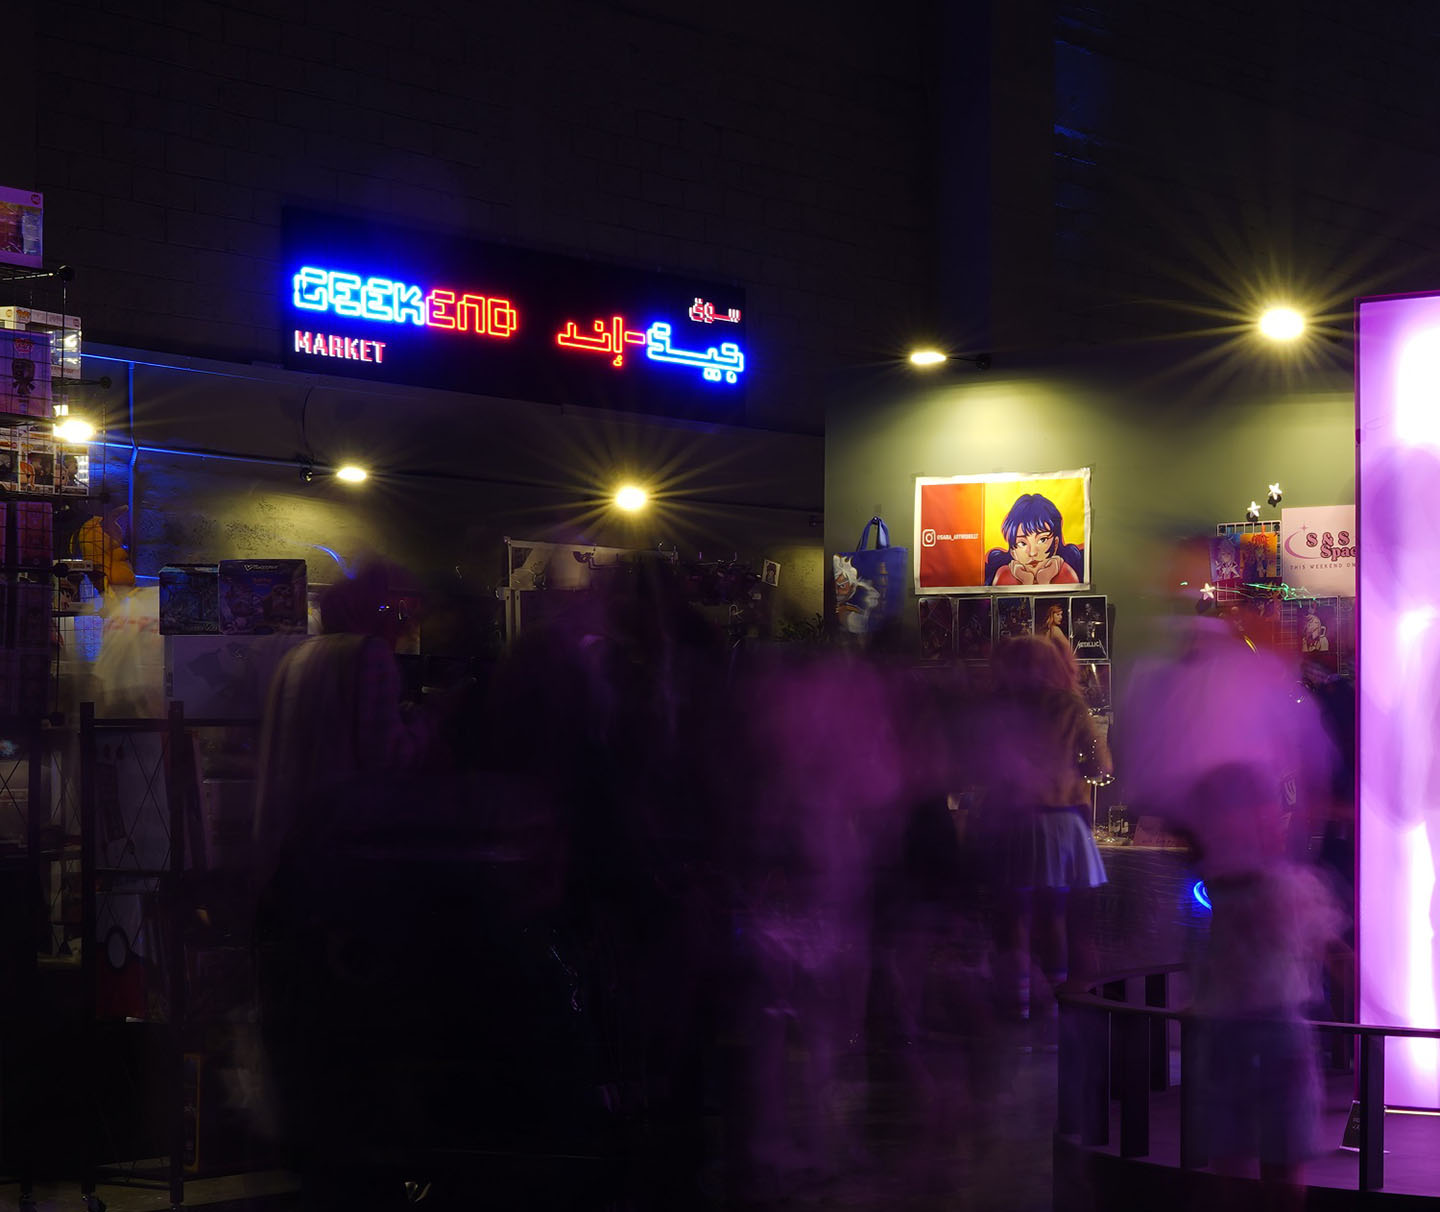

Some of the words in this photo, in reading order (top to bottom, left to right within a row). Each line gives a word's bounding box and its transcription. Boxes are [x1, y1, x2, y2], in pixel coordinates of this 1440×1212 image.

[294, 266, 518, 337] GEEKEND
[689, 297, 741, 324] سوق
[295, 330, 386, 364] MARKET
[1306, 532, 1318, 547] S
[1338, 530, 1351, 546] S
